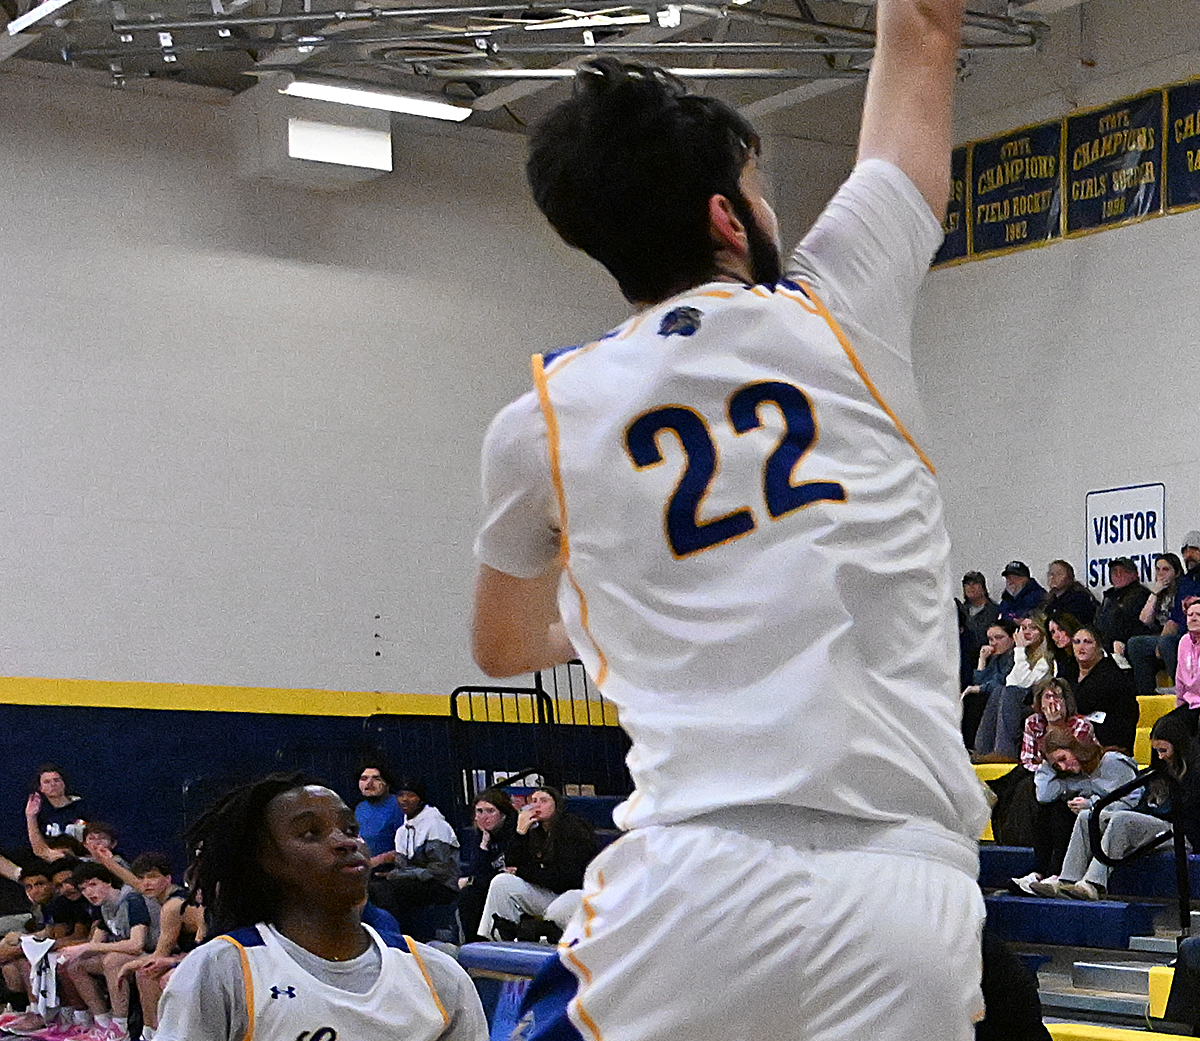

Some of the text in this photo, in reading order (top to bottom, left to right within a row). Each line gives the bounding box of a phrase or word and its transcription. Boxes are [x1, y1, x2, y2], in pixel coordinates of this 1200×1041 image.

[1073, 126, 1155, 171] CHAMPIONS
[977, 155, 1055, 195] CHAMPIONS
[620, 376, 848, 561] 22
[1092, 510, 1158, 546] VISITOR
